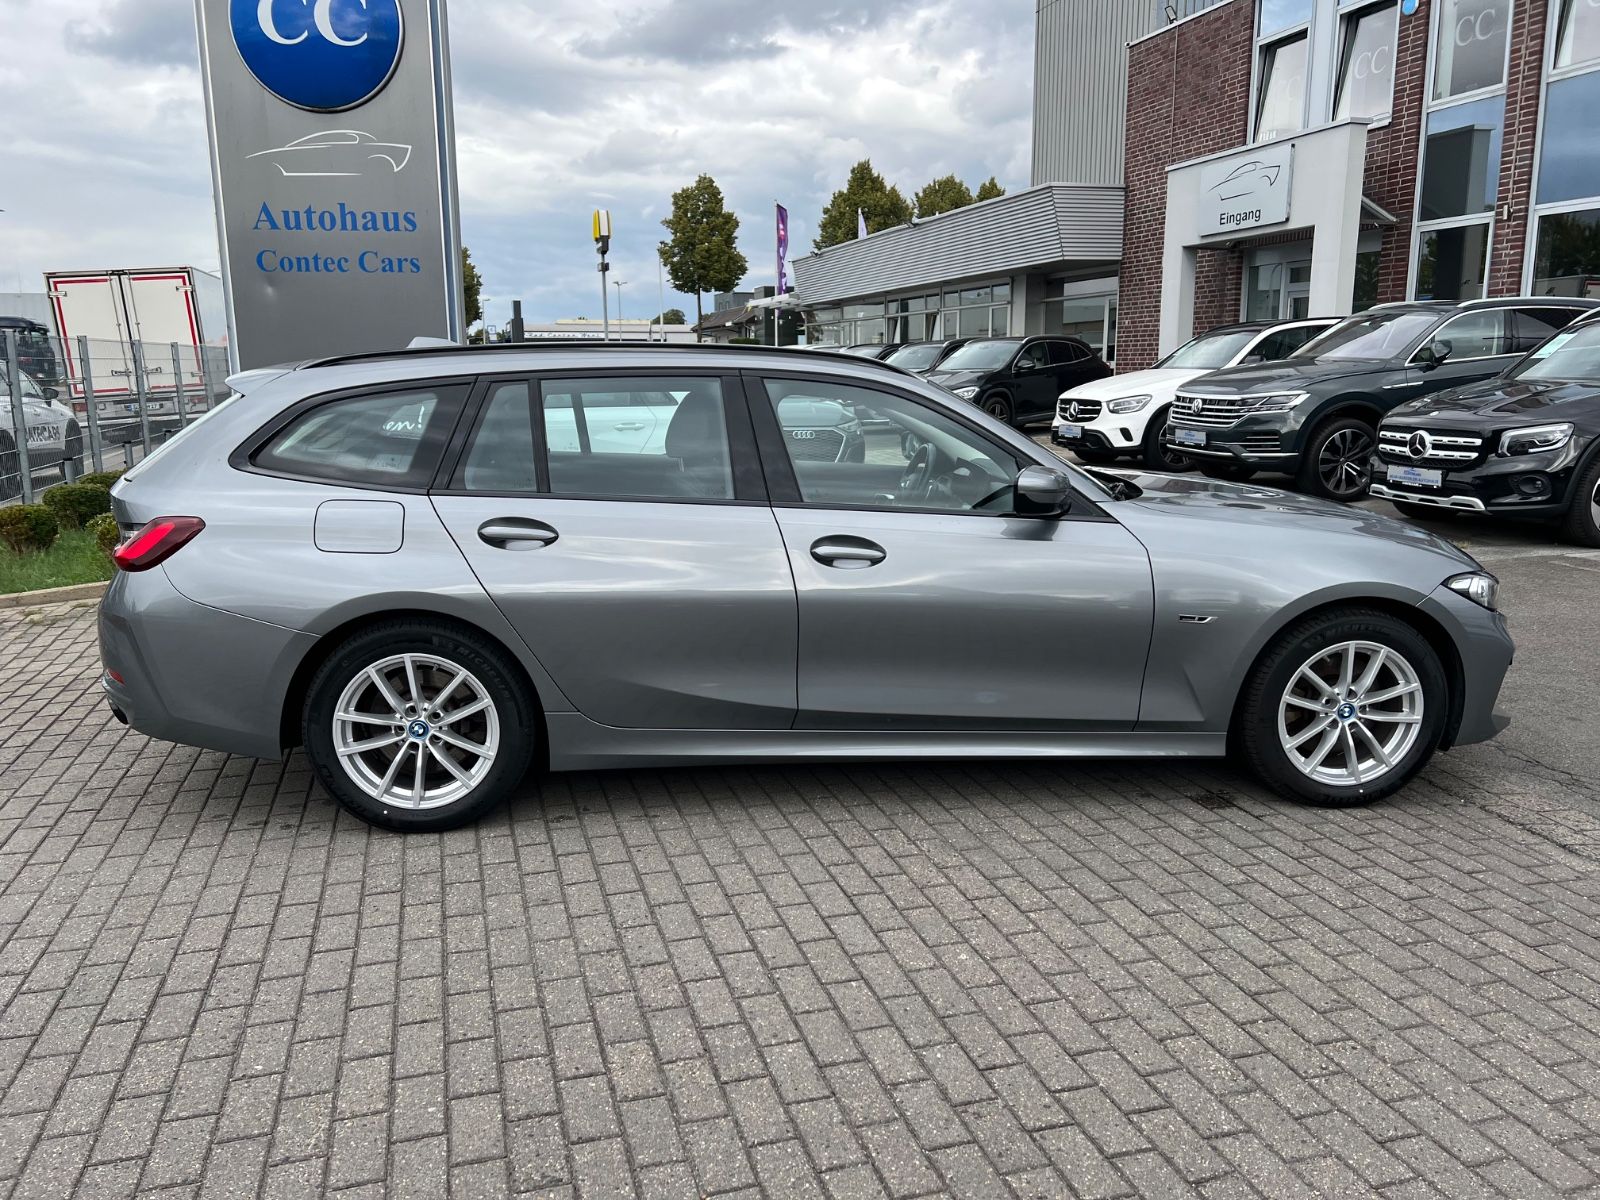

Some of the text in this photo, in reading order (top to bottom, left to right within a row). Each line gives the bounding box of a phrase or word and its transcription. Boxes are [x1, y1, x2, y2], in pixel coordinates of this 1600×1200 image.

[257, 0, 368, 47] CC
[1455, 9, 1496, 46] CC
[1354, 45, 1389, 80] CC
[253, 201, 417, 232] Autohaus
[1219, 209, 1261, 225] Eingang
[256, 250, 421, 273] Contec Cars
